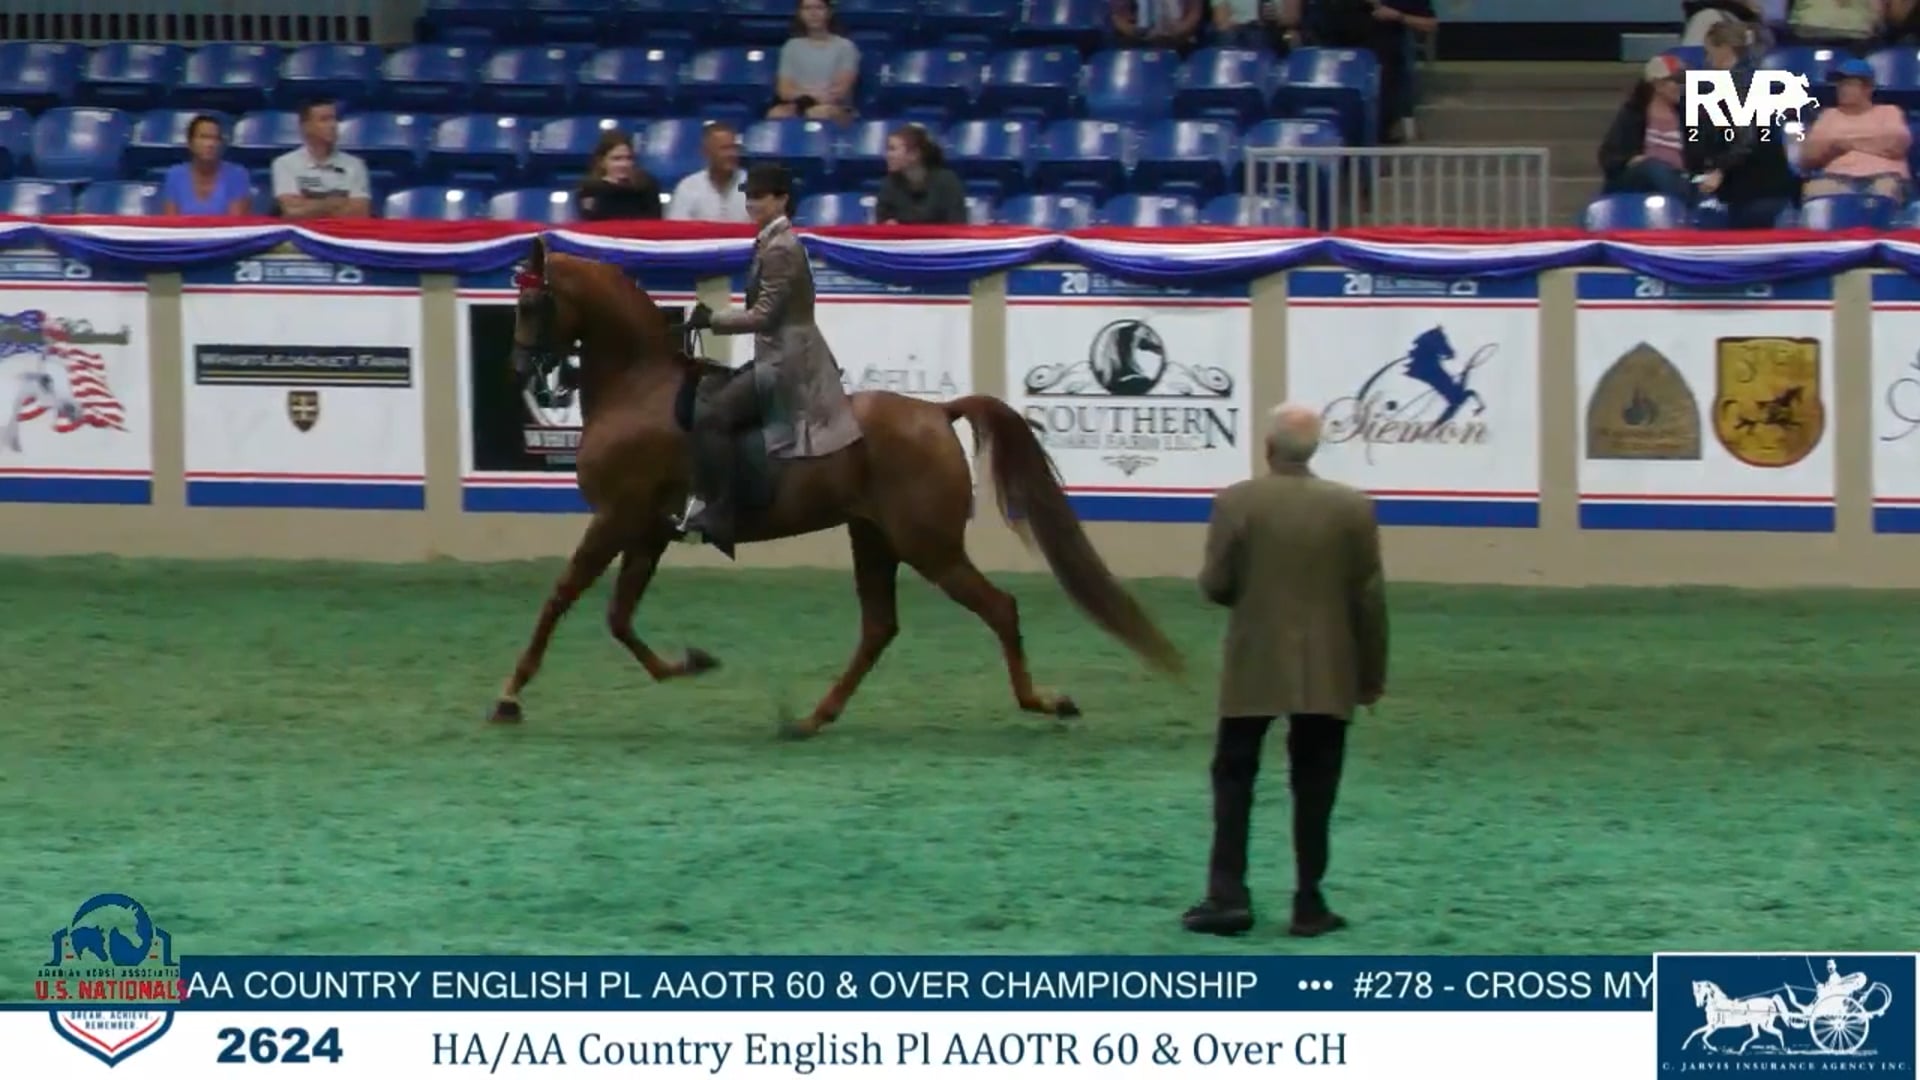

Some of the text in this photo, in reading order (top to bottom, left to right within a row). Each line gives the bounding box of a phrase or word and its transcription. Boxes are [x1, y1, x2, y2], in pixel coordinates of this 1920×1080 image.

[1060, 271, 1089, 294] 20
[1343, 273, 1373, 295] 20
[1024, 405, 1239, 449] SOUTHERN
